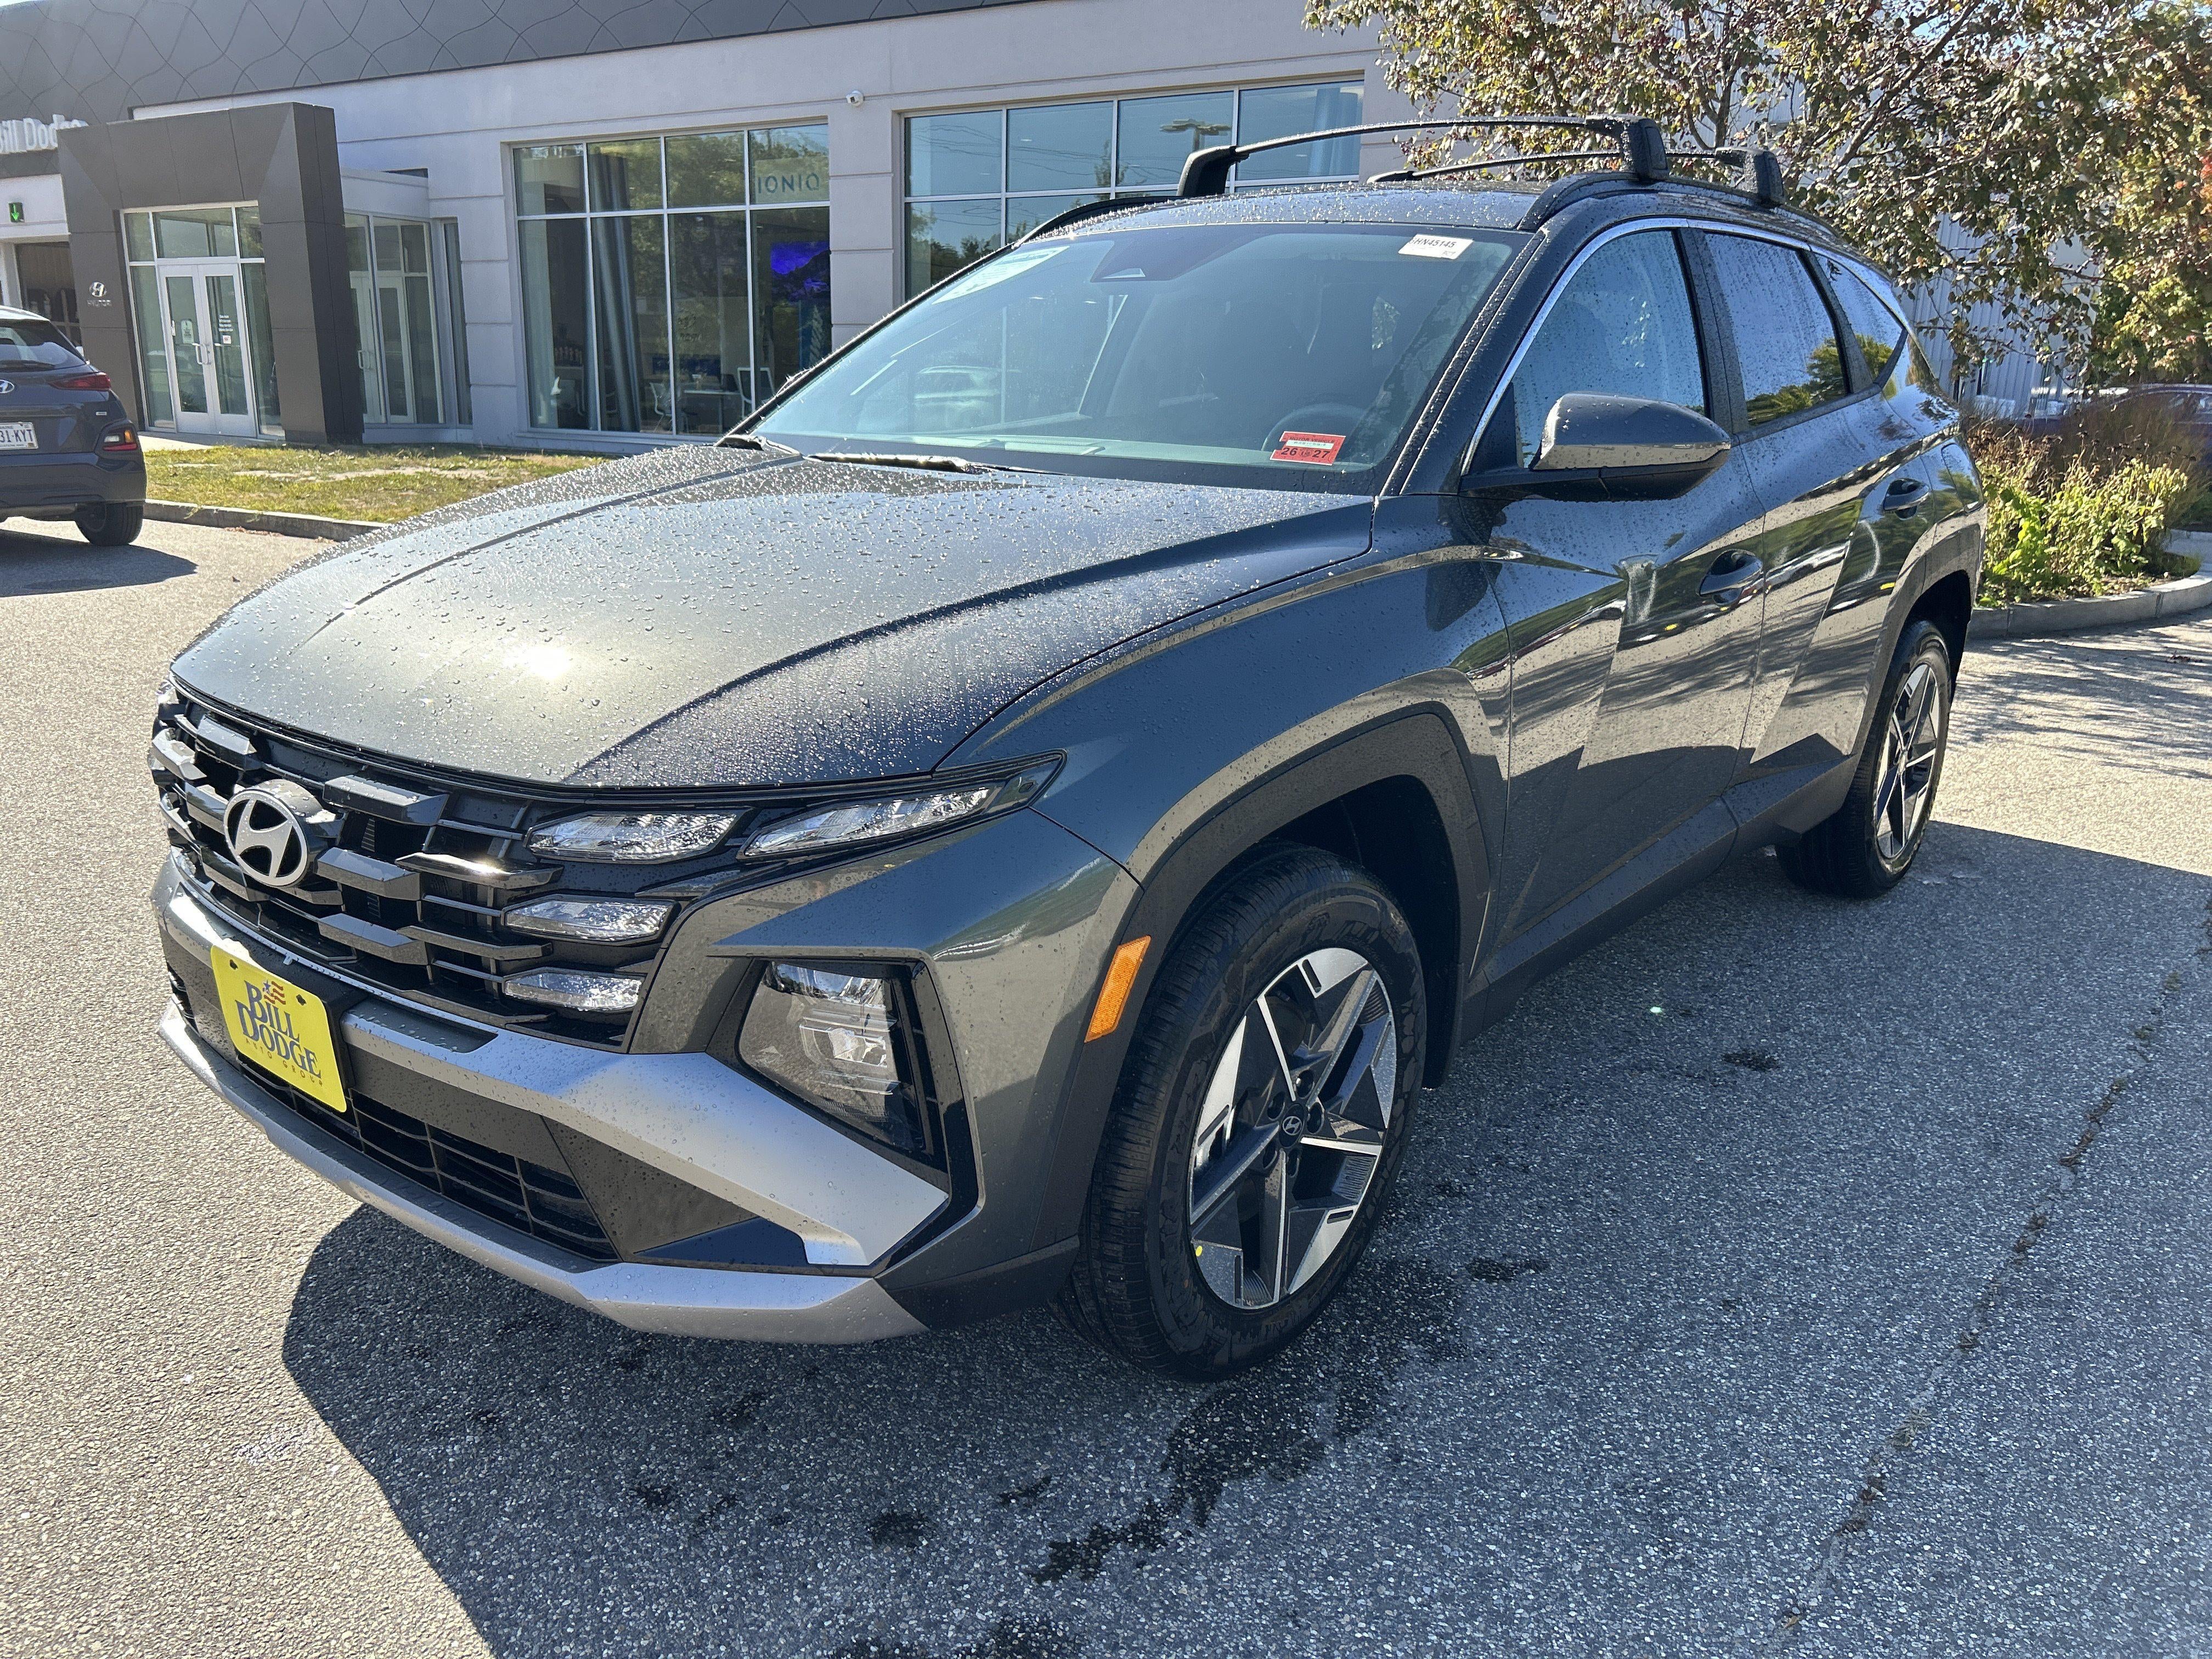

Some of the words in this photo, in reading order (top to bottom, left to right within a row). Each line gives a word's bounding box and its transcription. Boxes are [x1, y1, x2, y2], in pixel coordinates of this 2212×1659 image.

[0, 119, 26, 154] ill
[23, 114, 88, 150] Dod
[758, 173, 820, 194] IONIQ
[1281, 447, 1298, 456] 26
[1312, 450, 1330, 458] 27
[244, 980, 300, 1042] BILL
[235, 1000, 321, 1079] DODGE
